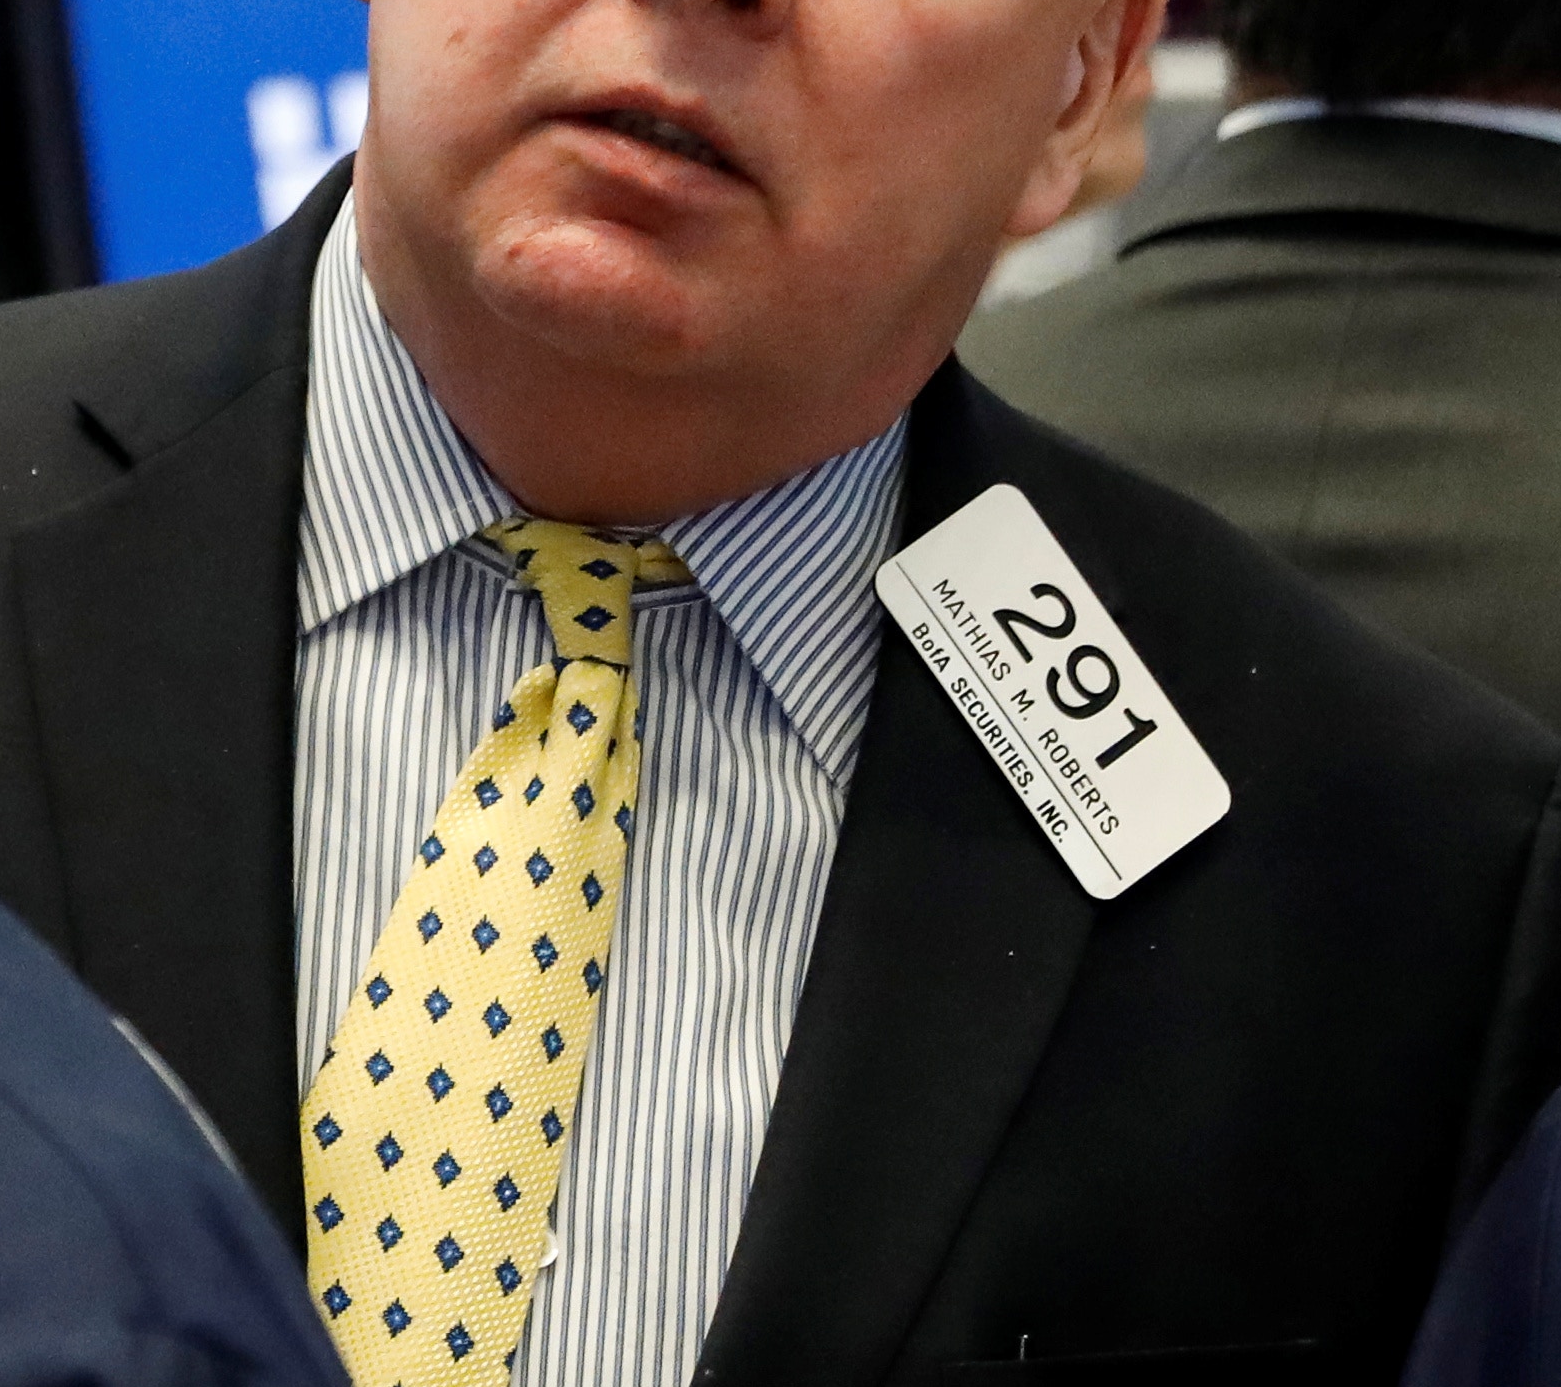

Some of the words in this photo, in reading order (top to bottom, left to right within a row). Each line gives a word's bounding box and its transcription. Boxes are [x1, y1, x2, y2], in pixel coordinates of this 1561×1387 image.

[912, 621, 952, 674] BofA
[1036, 798, 1069, 843] INC.
[932, 578, 1012, 682] MATHIAS
[1011, 688, 1035, 722] M.
[1037, 727, 1121, 836] ROBERTS
[992, 582, 1159, 770] 291
